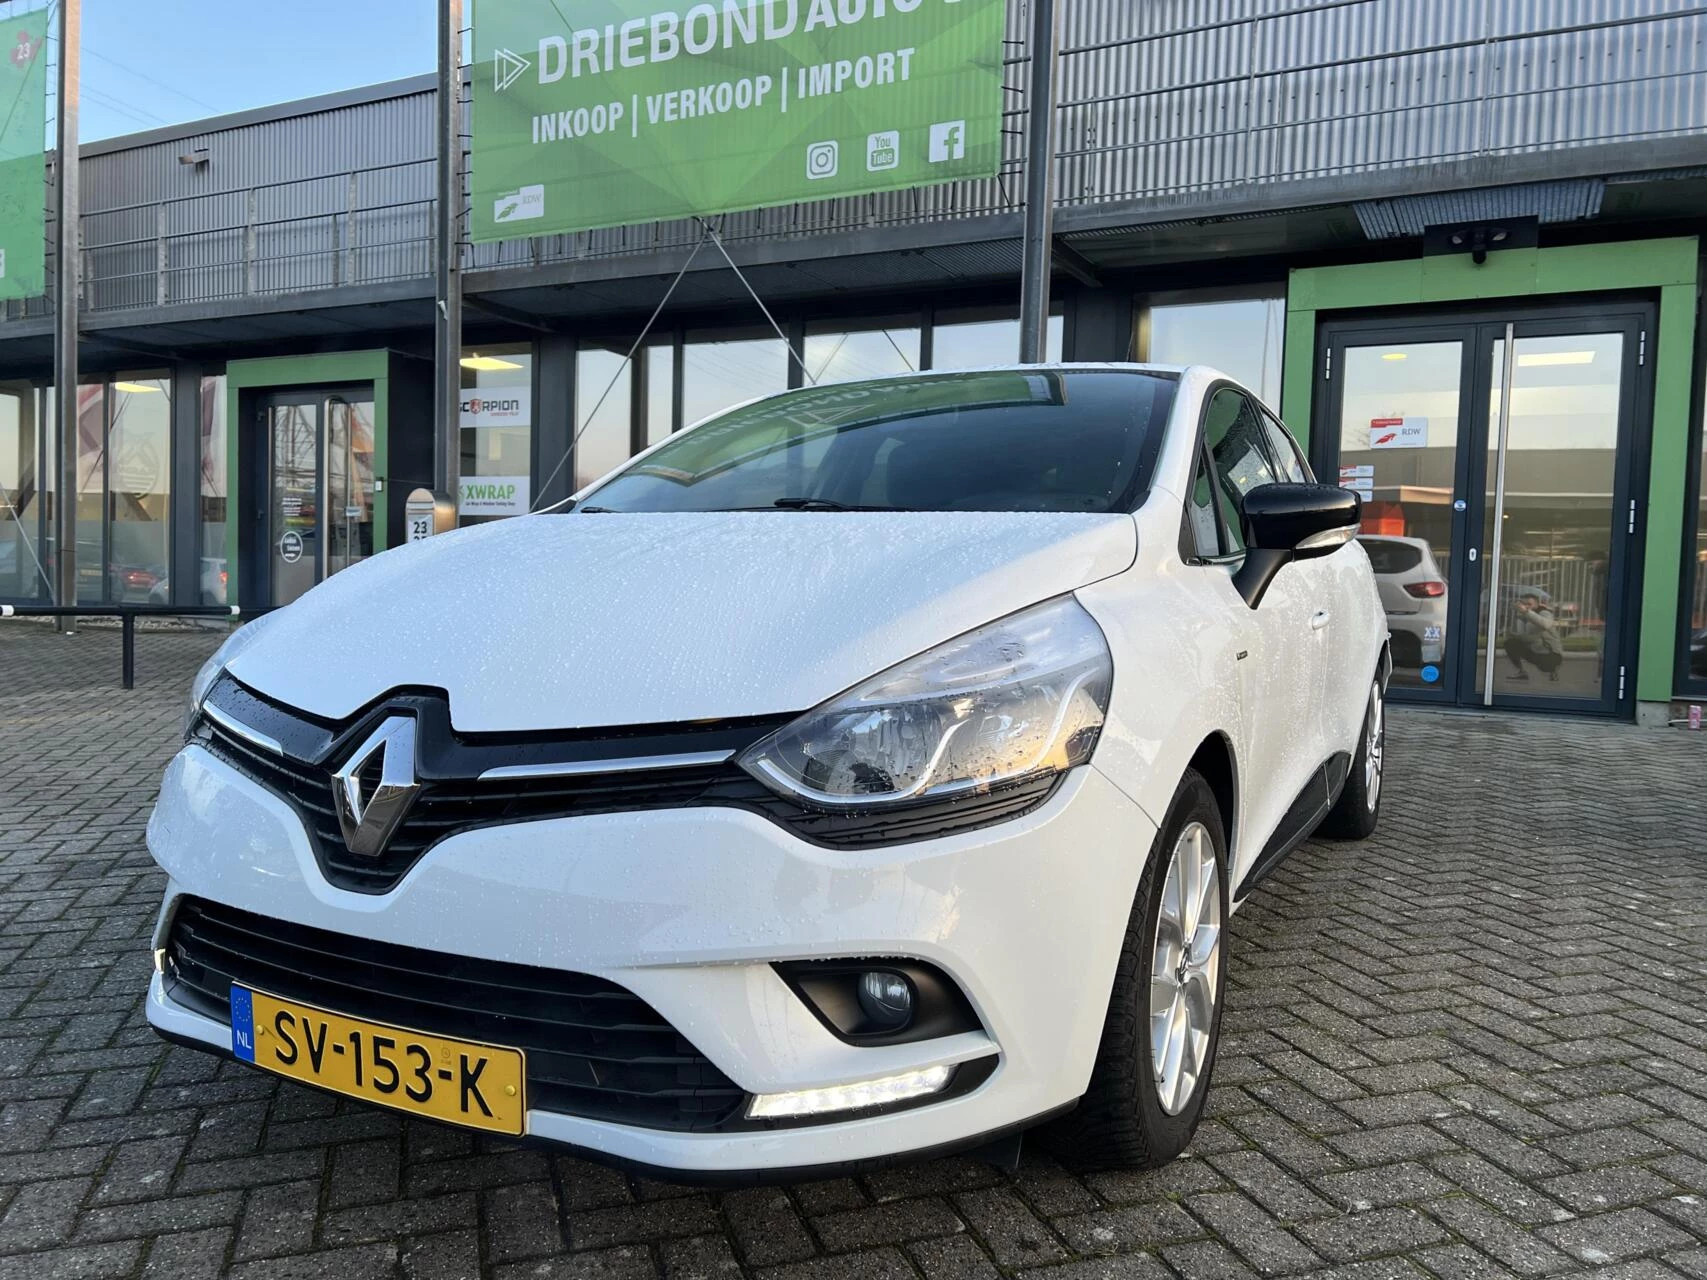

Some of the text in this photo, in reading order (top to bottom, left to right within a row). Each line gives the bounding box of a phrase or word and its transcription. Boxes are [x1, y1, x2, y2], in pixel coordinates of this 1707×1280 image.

[532, 102, 624, 144] INKOOP
[646, 75, 773, 124] VERKOOP
[798, 48, 915, 99] IMPORT
[875, 136, 891, 148] You
[872, 151, 893, 165] Tube
[1401, 428, 1421, 436] RDW
[466, 484, 516, 500] XWRAP
[413, 521, 427, 534] 23
[236, 1029, 252, 1049] NL
[274, 1010, 493, 1118] SV-153-K
